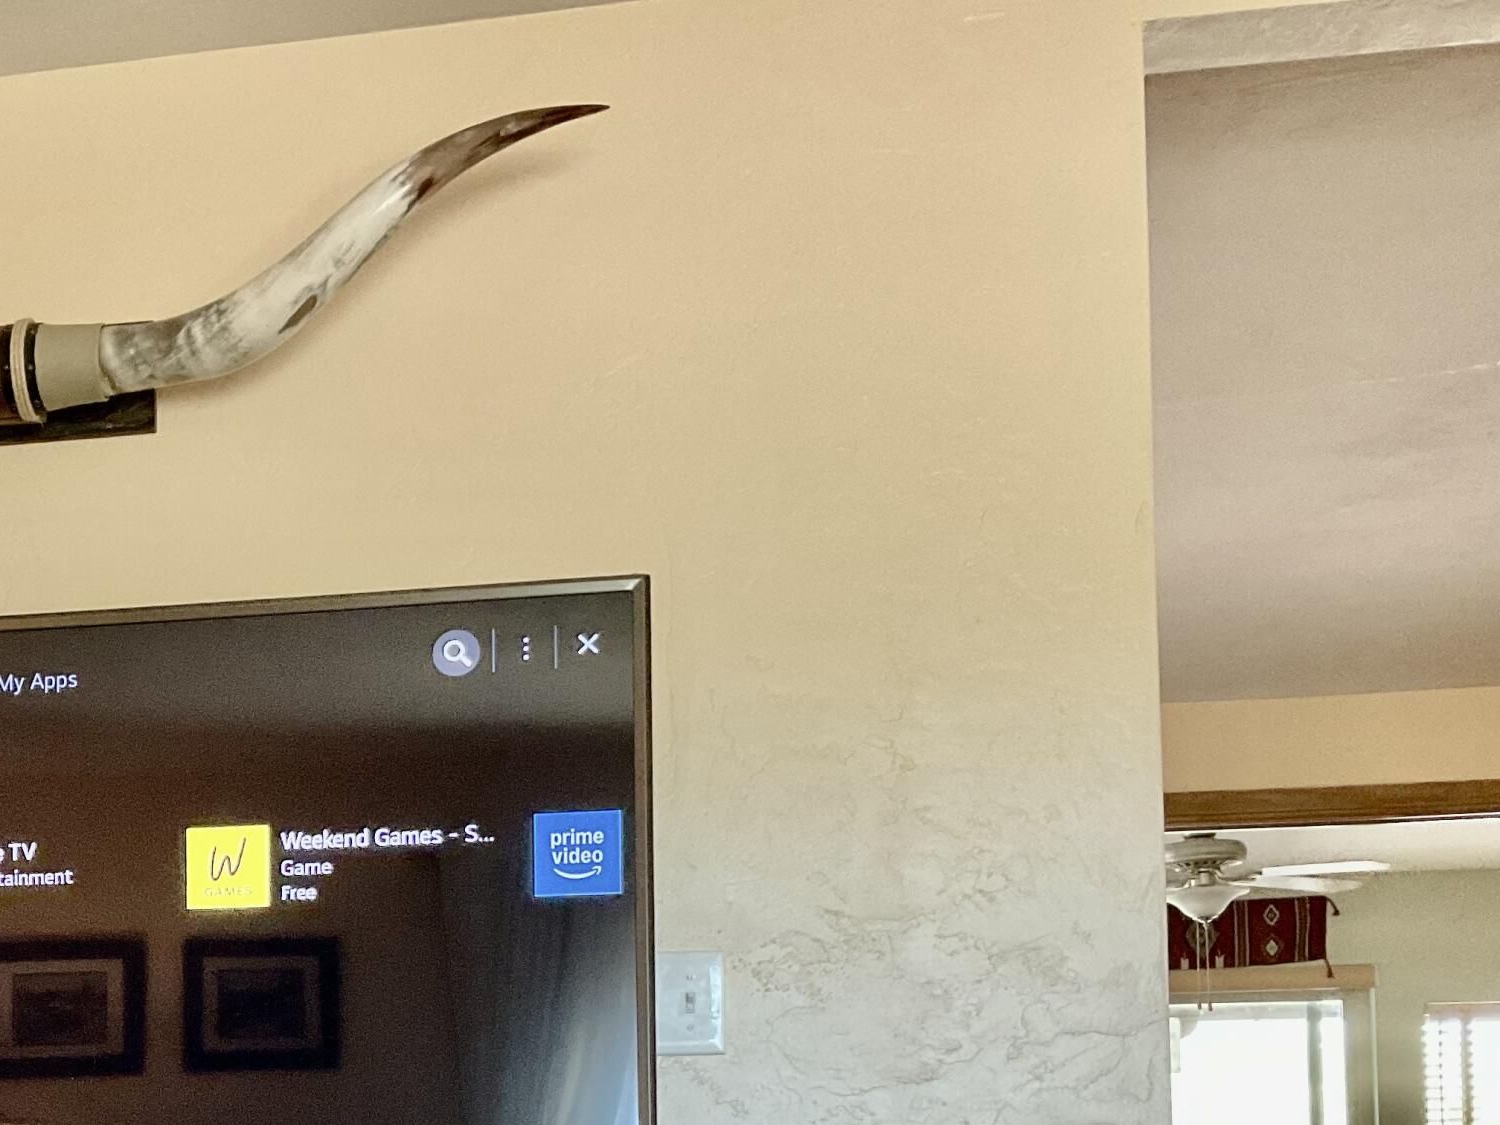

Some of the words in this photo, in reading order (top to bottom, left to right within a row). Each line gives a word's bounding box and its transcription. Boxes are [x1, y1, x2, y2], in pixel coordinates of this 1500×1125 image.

[30, 672, 78, 693] Apps
[280, 828, 370, 850] Weekend
[374, 827, 444, 846] Games
[550, 828, 604, 849] prime
[8, 842, 37, 861] TV
[211, 837, 247, 881] W
[552, 848, 604, 865] video
[280, 859, 333, 876] Game
[204, 886, 253, 897] GAMES
[280, 885, 318, 901] Free
